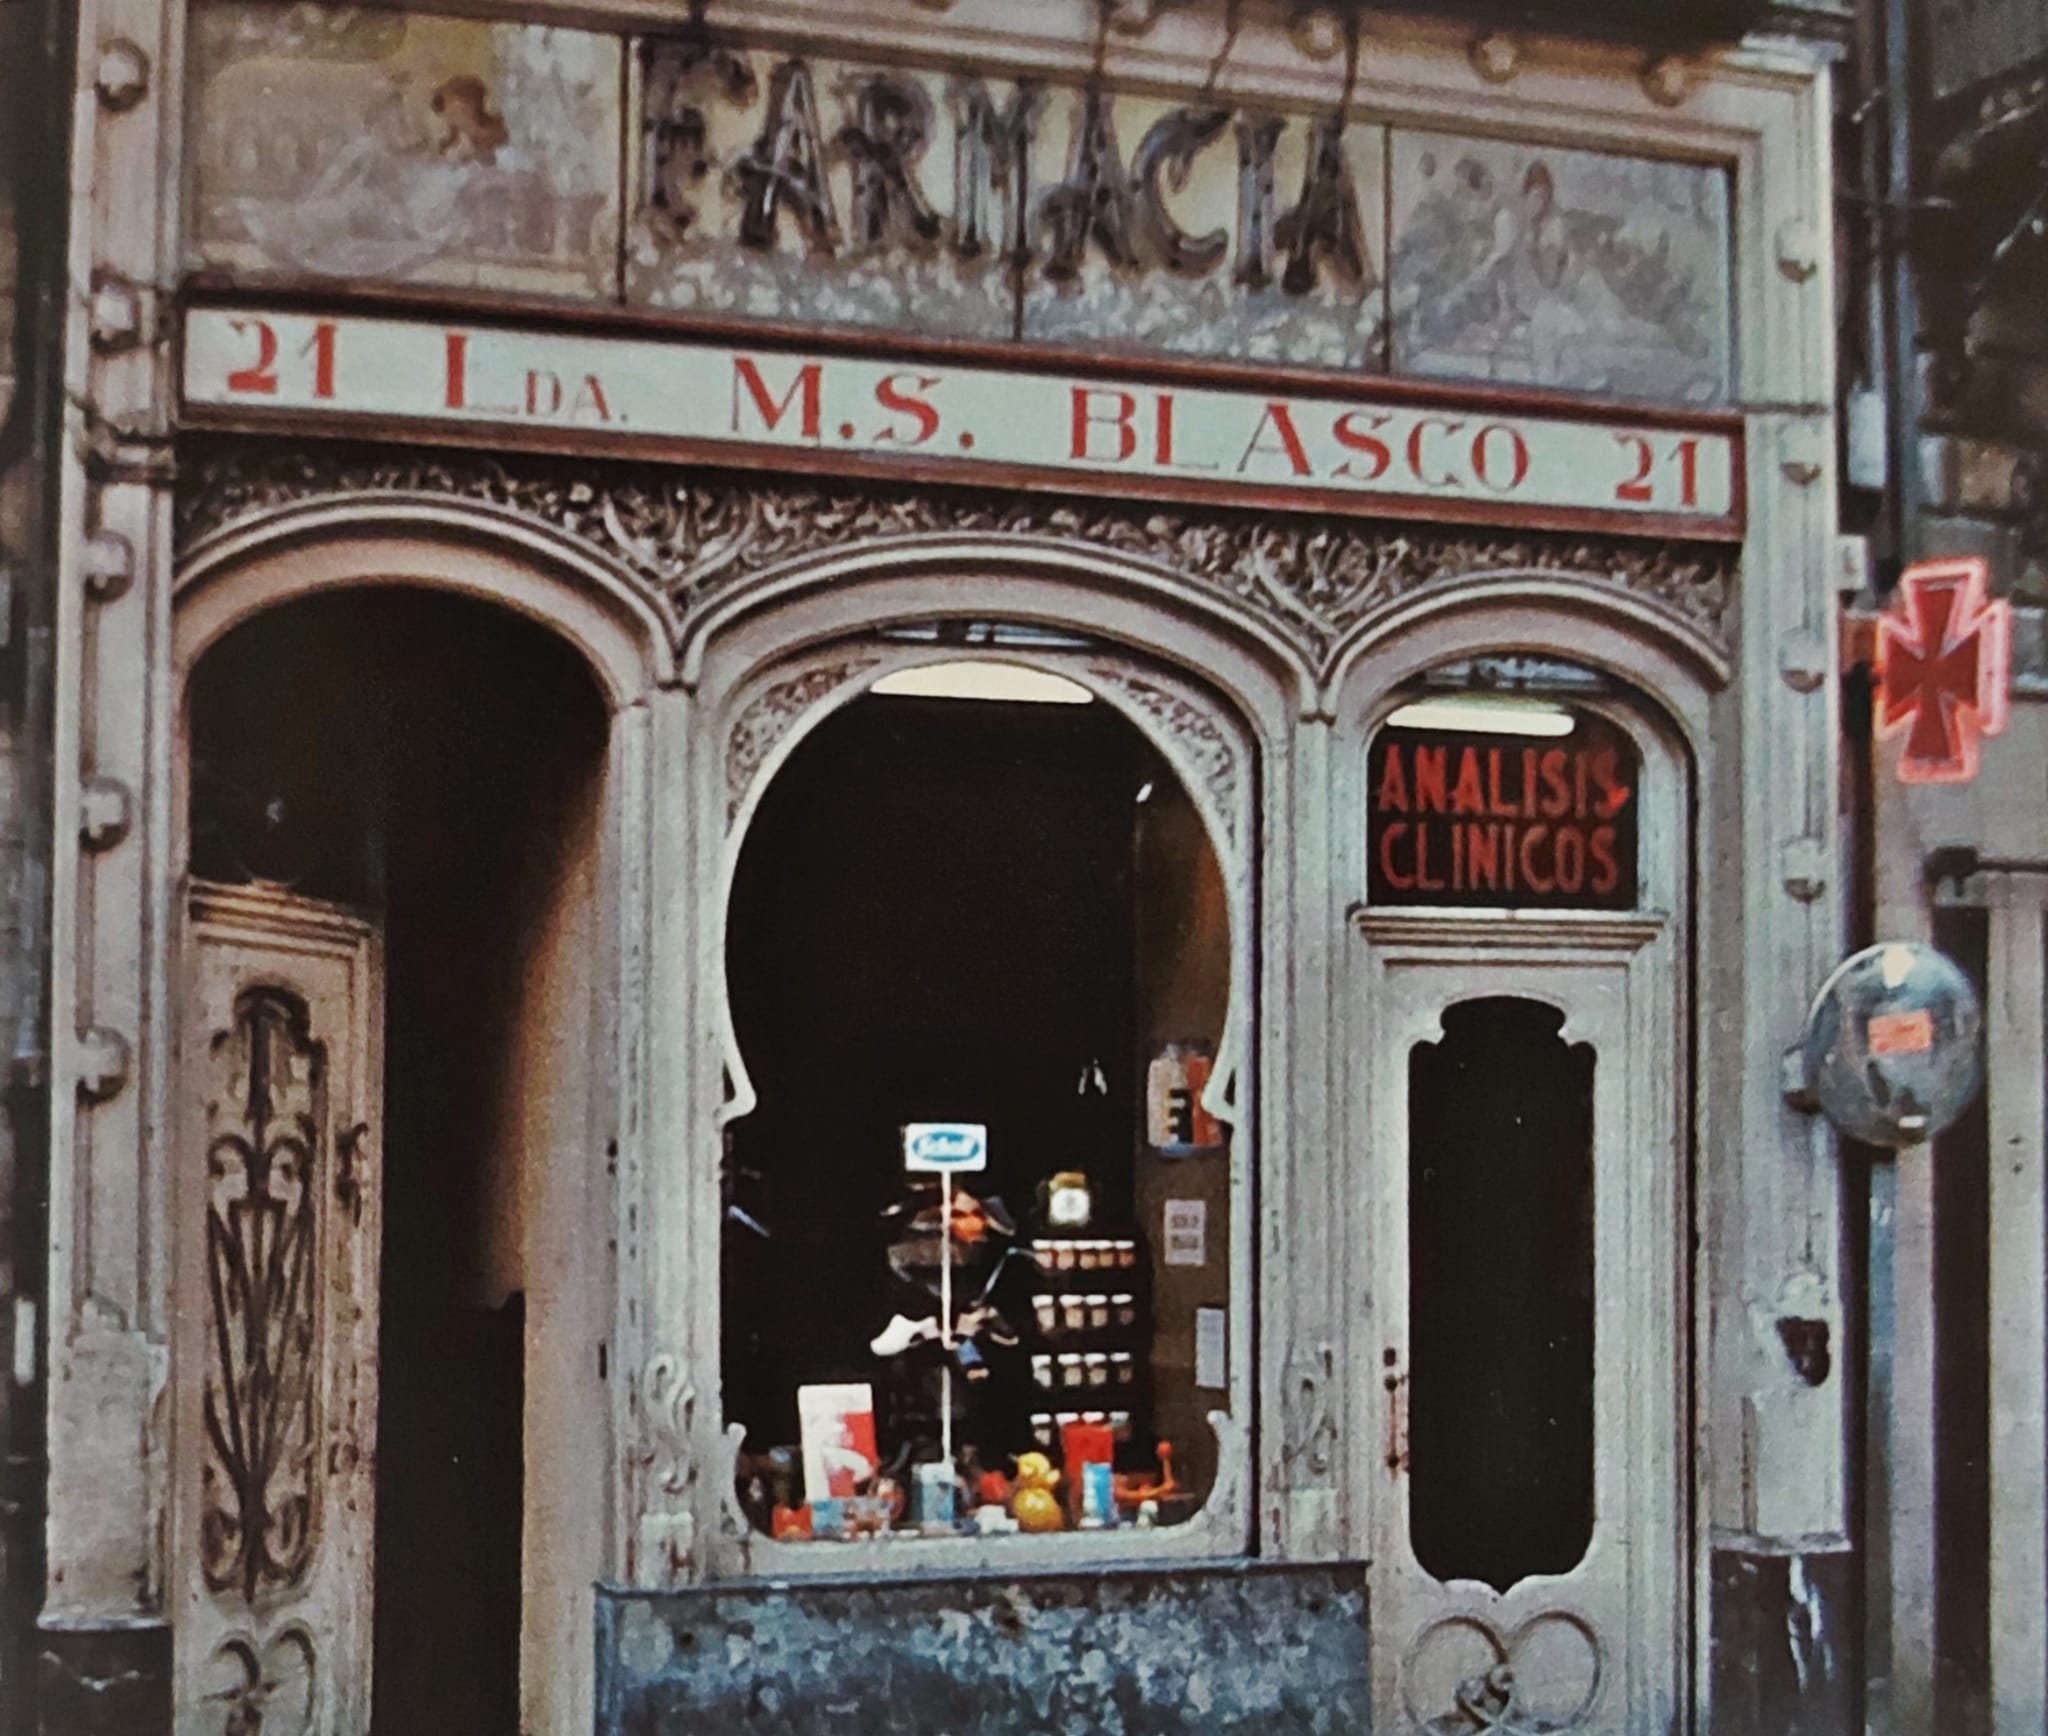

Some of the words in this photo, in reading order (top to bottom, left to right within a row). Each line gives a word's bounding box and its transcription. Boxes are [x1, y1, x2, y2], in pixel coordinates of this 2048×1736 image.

[638, 42, 1376, 300] FARMACIA
[227, 318, 338, 399] 21
[1070, 387, 1531, 493] BLASCO
[1613, 434, 1697, 507] 21
[1378, 743, 1630, 819] ANALISIS
[1380, 822, 1618, 894] CLINICOS
